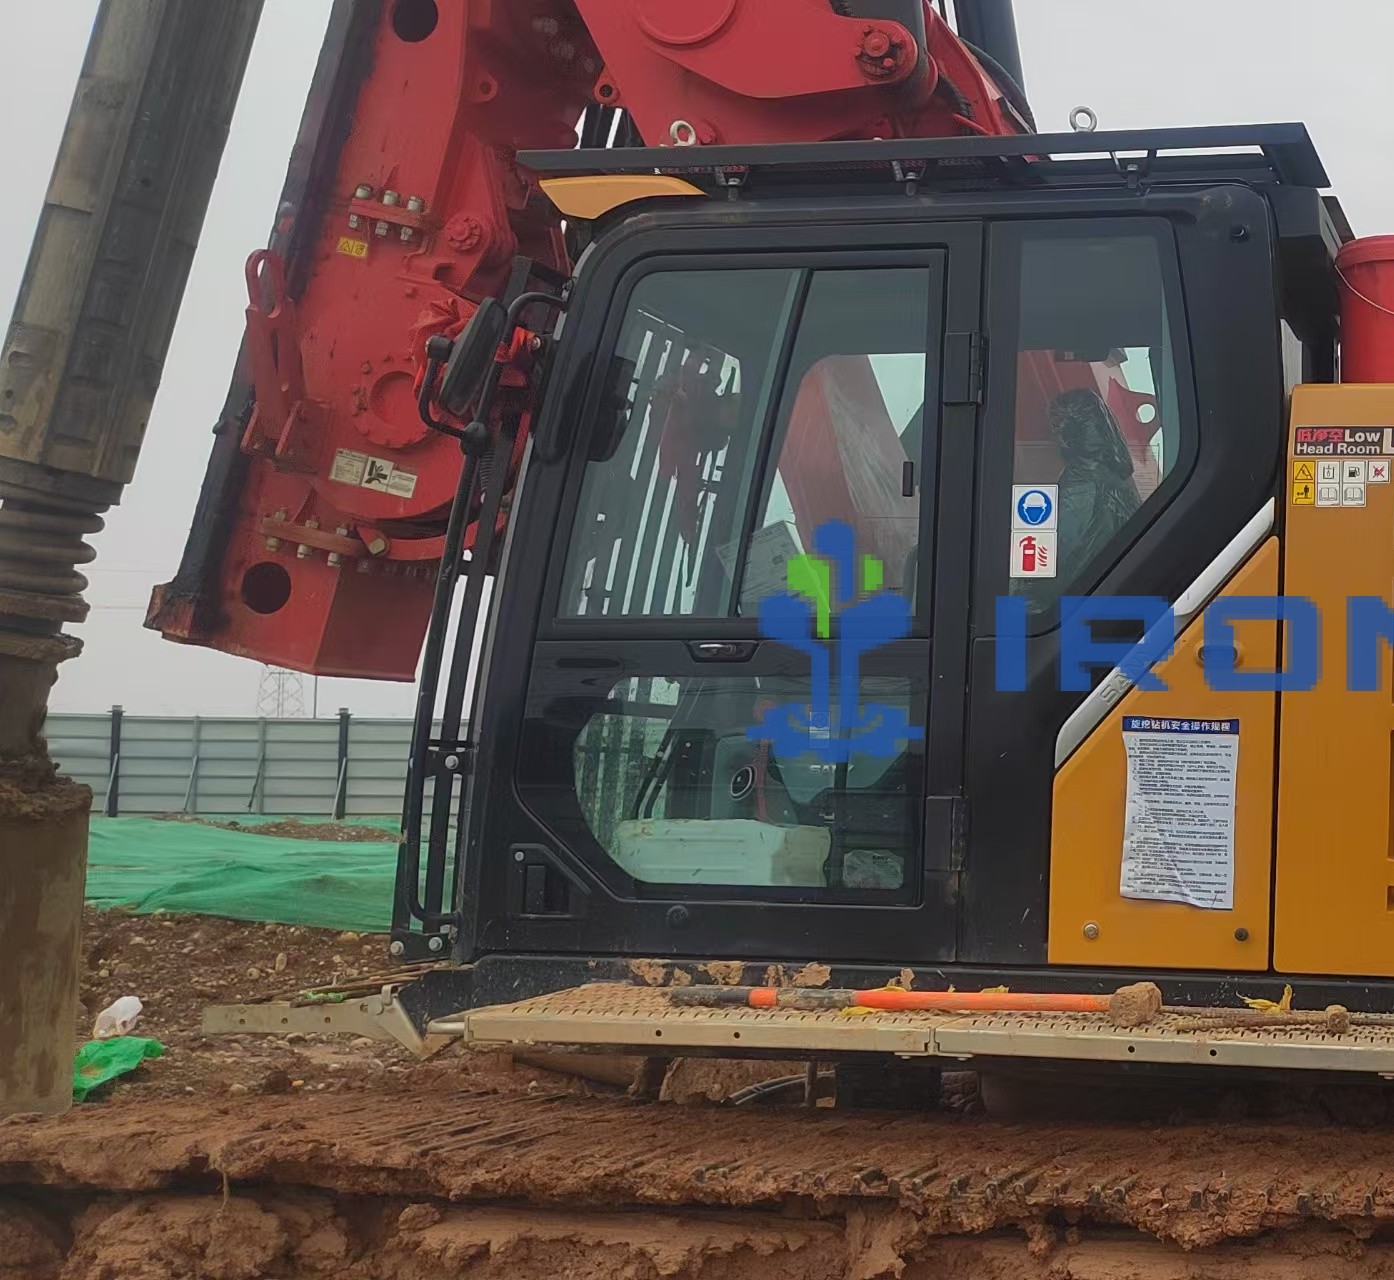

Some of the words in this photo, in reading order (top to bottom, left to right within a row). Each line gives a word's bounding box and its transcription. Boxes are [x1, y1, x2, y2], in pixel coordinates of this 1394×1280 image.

[1297, 429, 1344, 443] 低净空
[1344, 429, 1380, 443] Low
[1296, 443, 1333, 454] Head
[1337, 443, 1380, 454] Room
[1131, 718, 1231, 732] 旋挖钻机安全操作规程
